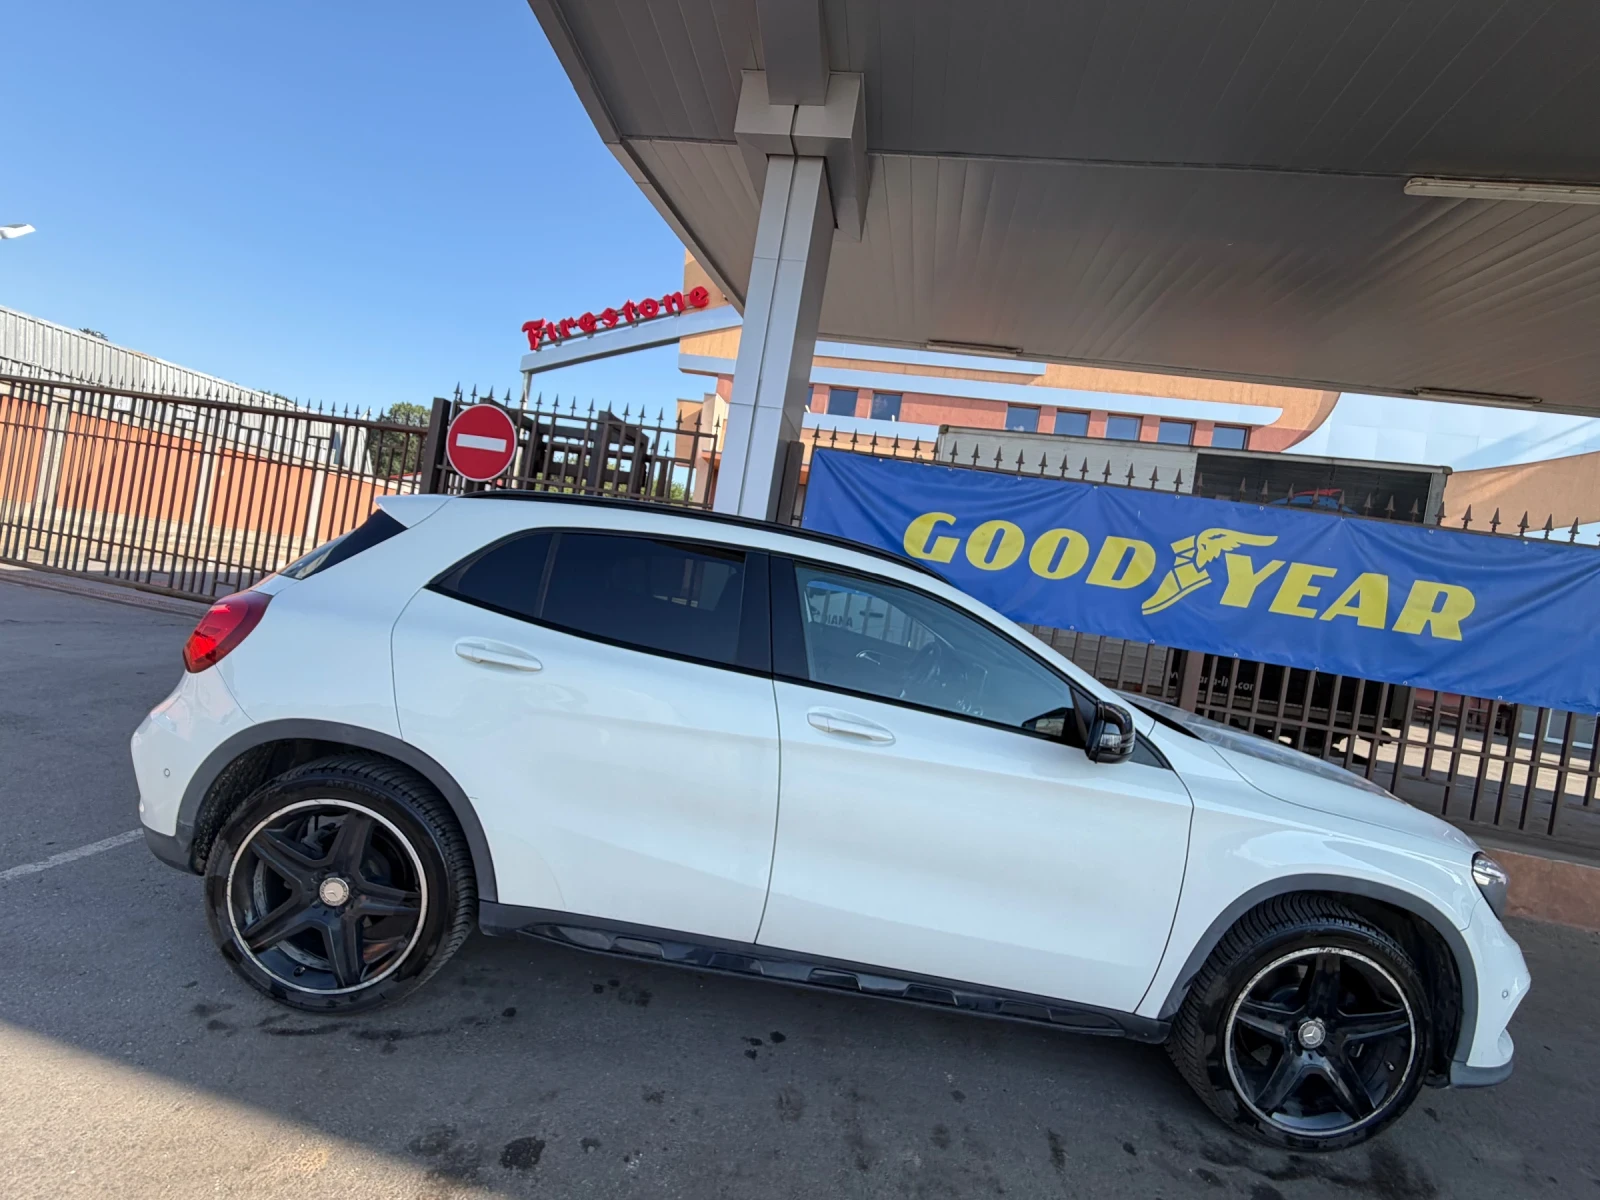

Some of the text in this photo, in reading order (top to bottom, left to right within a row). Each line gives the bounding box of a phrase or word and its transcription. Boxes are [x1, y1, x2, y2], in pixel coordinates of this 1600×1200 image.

[522, 286, 709, 350] Firestone
[903, 511, 1477, 641] GOOD YEAR
